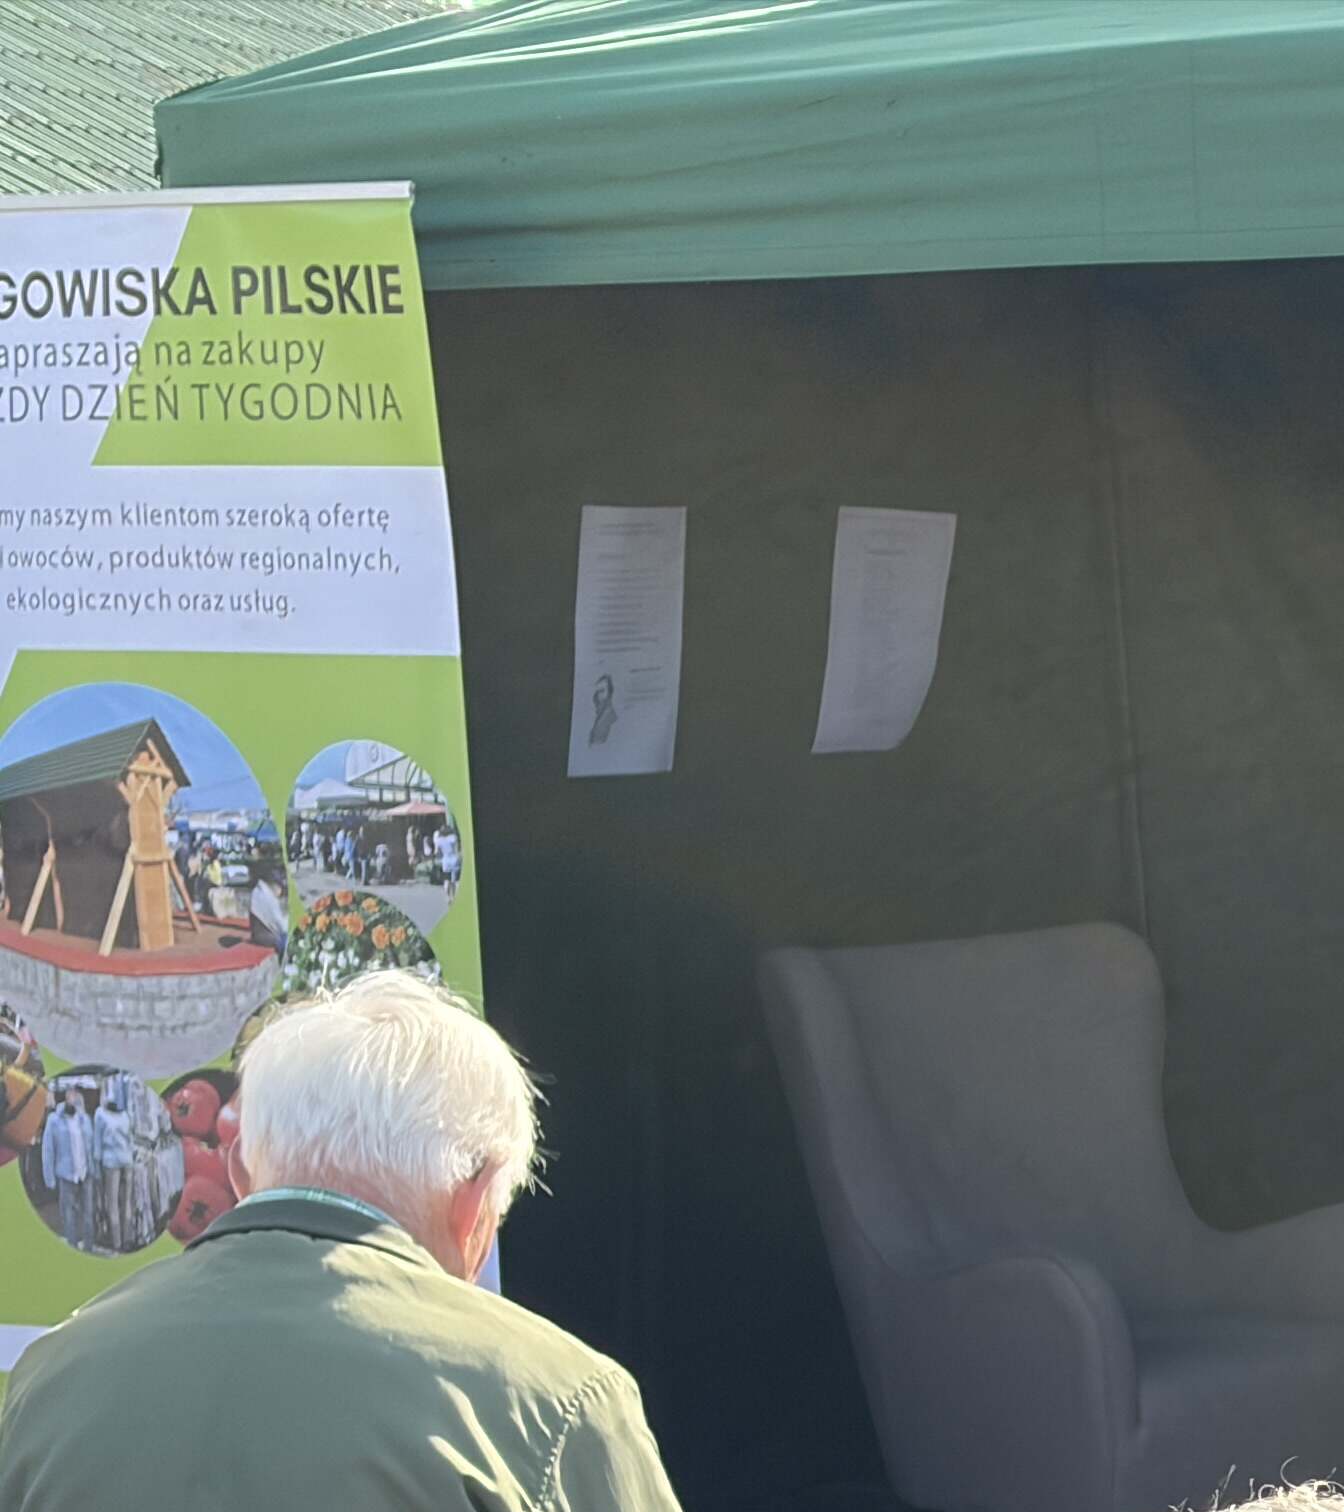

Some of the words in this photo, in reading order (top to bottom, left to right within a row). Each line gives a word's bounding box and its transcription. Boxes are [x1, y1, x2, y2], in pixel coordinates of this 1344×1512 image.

[231, 264, 404, 315] PILSKIE
[155, 340, 192, 367] na
[202, 329, 325, 375] zakupy
[0, 384, 51, 423] DY
[62, 375, 179, 422] DZIEŃ
[190, 382, 402, 422] TYGODNIA
[30, 506, 112, 532] naszym
[121, 501, 219, 527] klientom
[226, 502, 311, 534] szeroką
[317, 502, 390, 534] ofertę
[8, 544, 104, 572] owoców,
[109, 543, 234, 575] produktów
[241, 545, 400, 577] regionalnych,
[6, 586, 172, 617] ekologicznych
[178, 591, 225, 612] oraz
[230, 588, 296, 619] usług.
